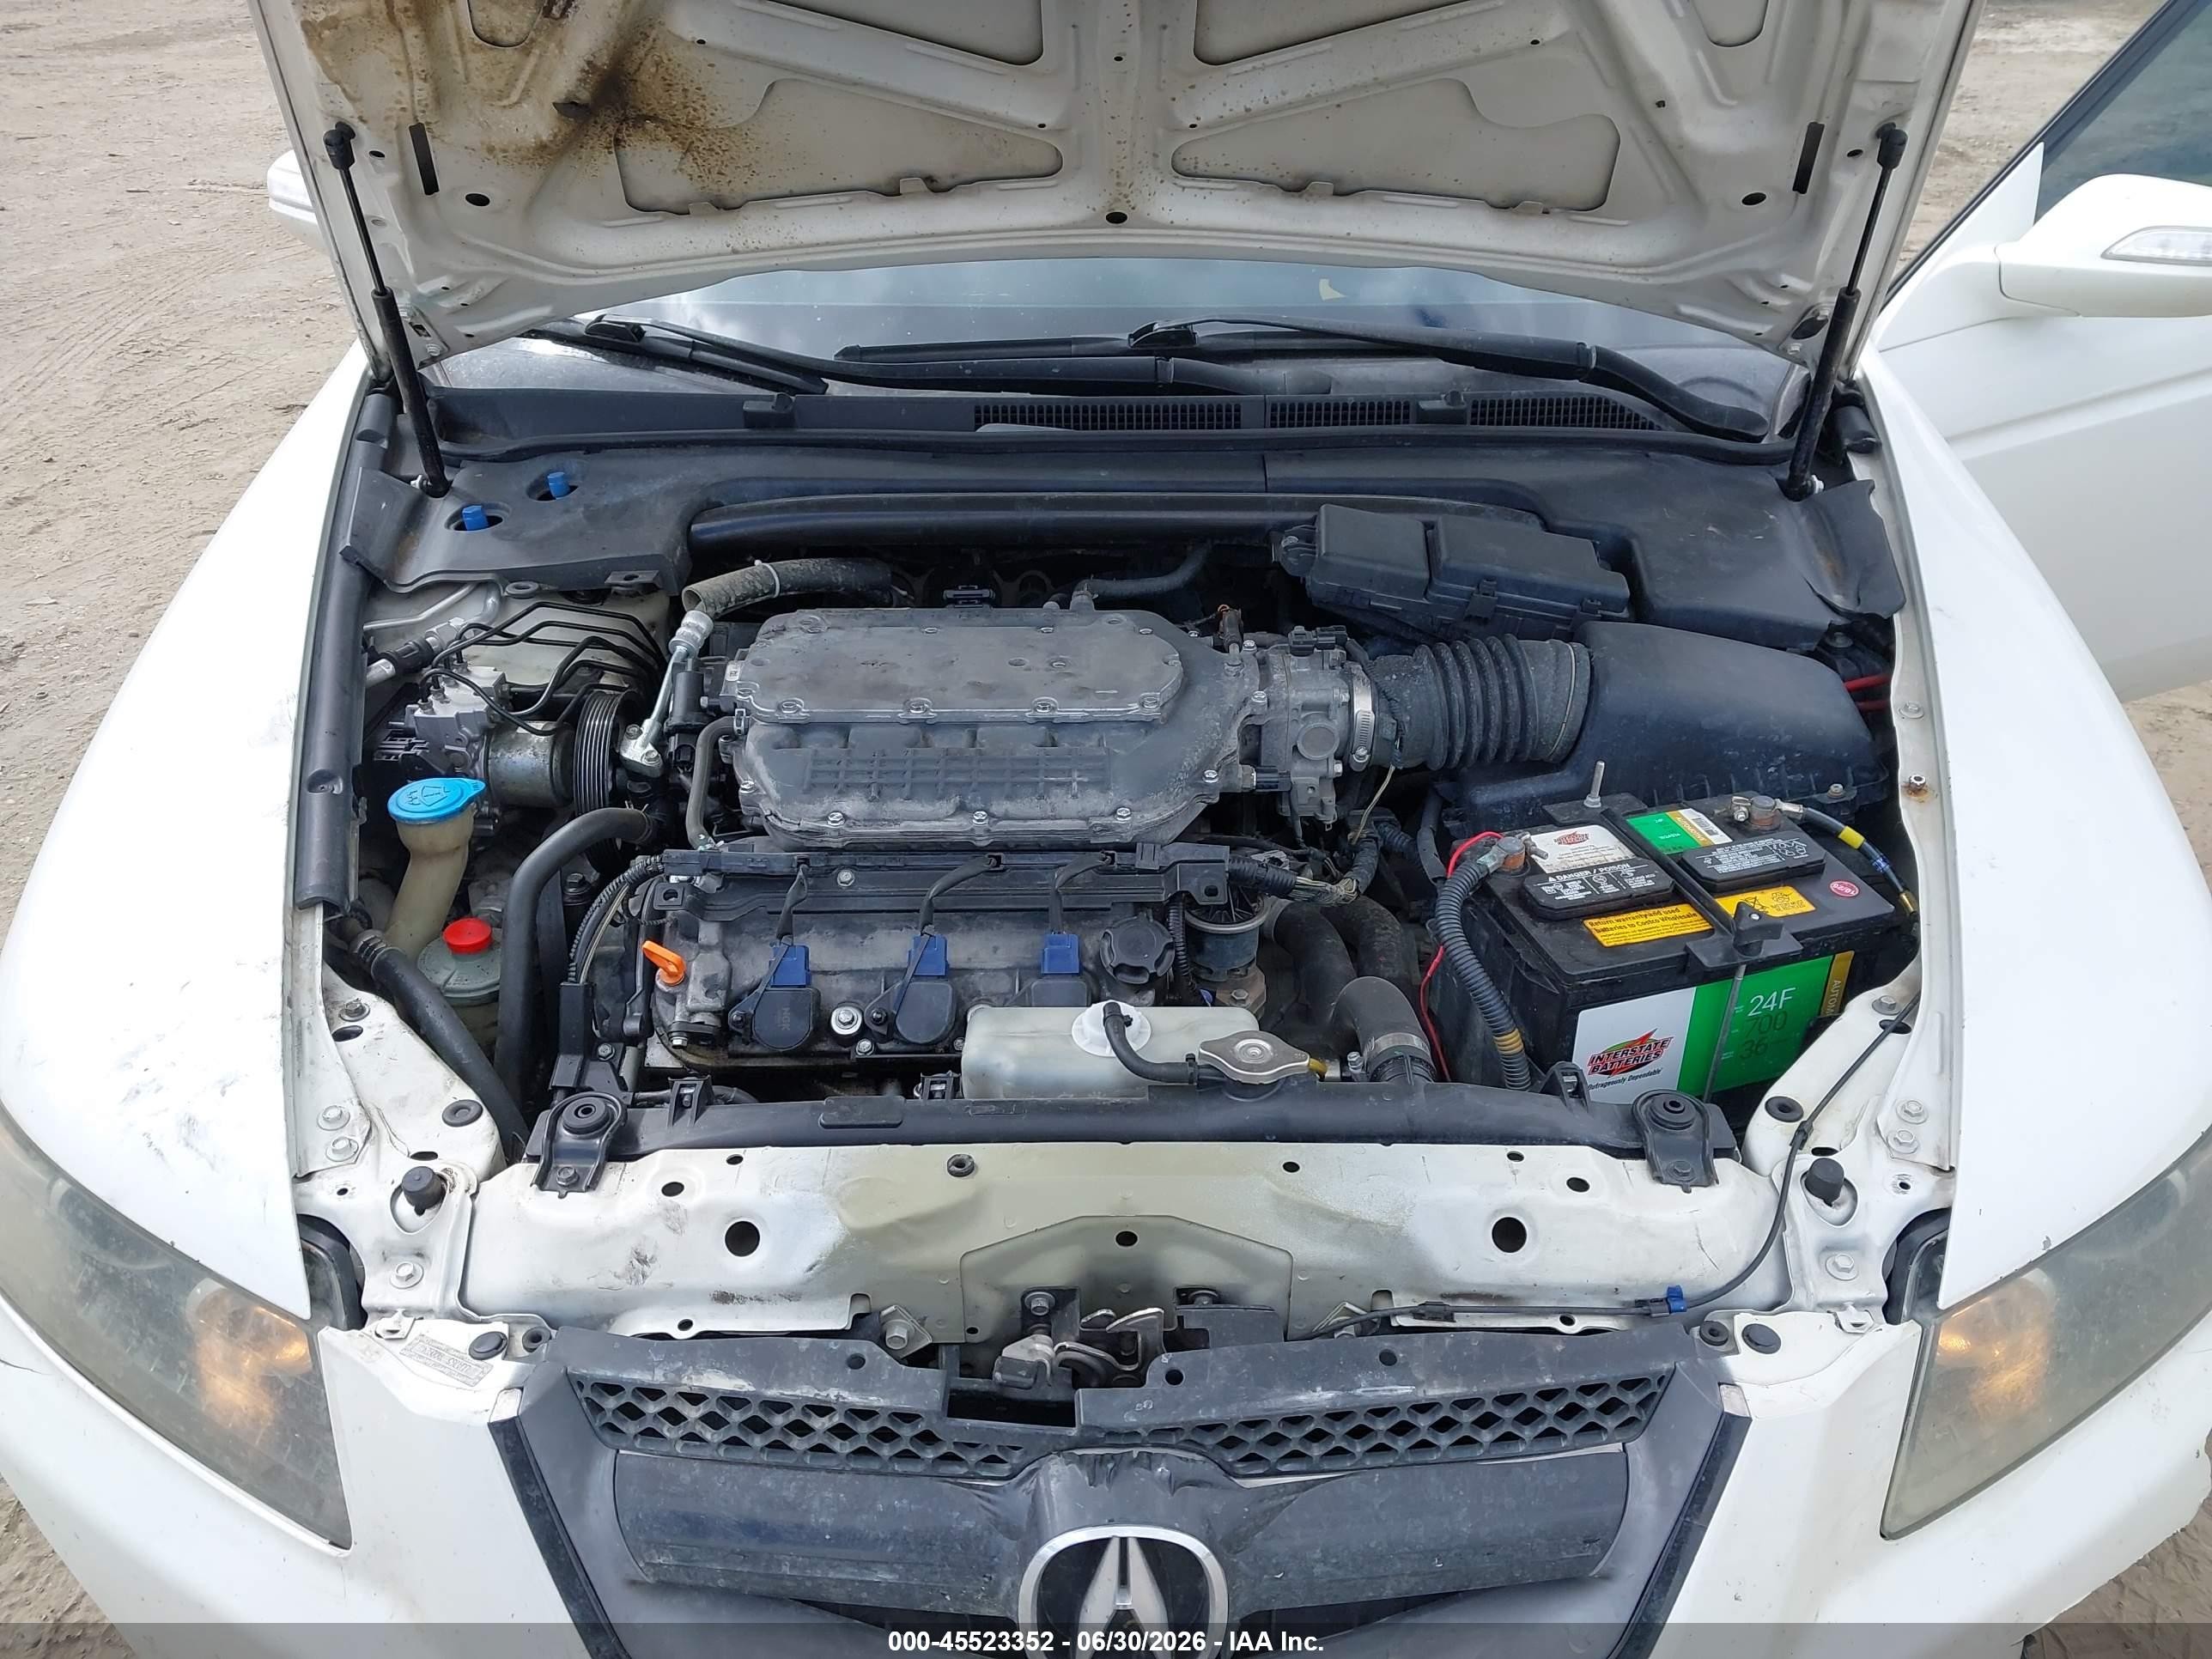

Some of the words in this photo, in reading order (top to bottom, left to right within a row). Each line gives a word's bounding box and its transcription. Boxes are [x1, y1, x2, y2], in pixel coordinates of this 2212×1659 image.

[1557, 870, 1591, 881] DANGER
[1599, 863, 1631, 873] POISON
[1589, 917, 1614, 927] Return
[1615, 914, 1647, 923] warranty
[1662, 907, 1680, 915] used
[1594, 924, 1626, 933] batteries
[1636, 918, 1660, 927] Costco
[1660, 912, 1698, 922] Wholesale
[1747, 987, 1796, 1017] 24F
[1746, 1011, 1789, 1038] 700
[1590, 1038, 1670, 1064] INTERSTATE
[1740, 1037, 1769, 1060] 36
[1591, 1049, 1662, 1073] BATTERIES
[1627, 1067, 1661, 1082] Dependable
